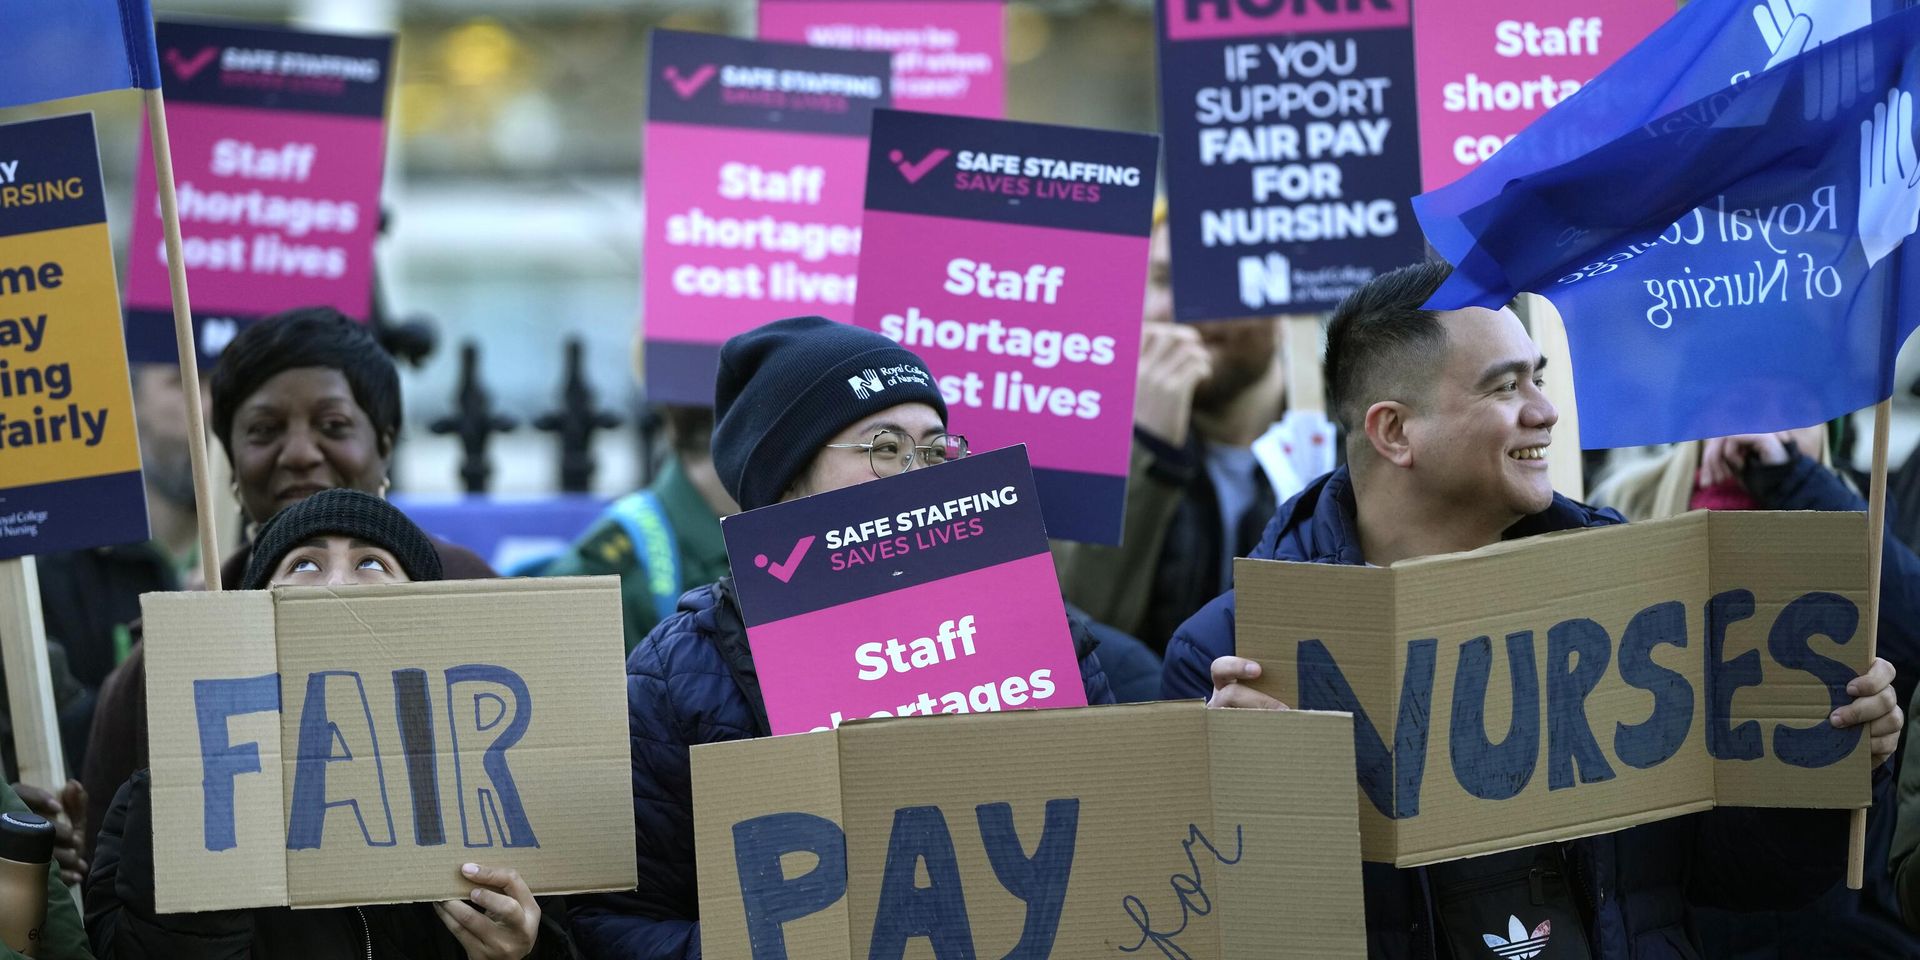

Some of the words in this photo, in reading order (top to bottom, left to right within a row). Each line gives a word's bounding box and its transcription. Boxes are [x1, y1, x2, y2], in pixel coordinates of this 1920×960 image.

[1224, 44, 1261, 81] IF
[1266, 38, 1357, 79] YOU
[1494, 17, 1603, 57] Staff
[720, 65, 776, 91] SAFE
[780, 69, 882, 98] STAFFING
[1195, 77, 1391, 125] SUPPORT
[1443, 73, 1592, 112] shorta
[211, 138, 316, 183] Staff
[1200, 123, 1301, 165] FAIR
[1305, 118, 1391, 159] PAY
[1453, 134, 1518, 166] co
[717, 161, 826, 205] Staff
[955, 172, 1030, 197] SAVES
[1035, 180, 1101, 203] LIVES
[956, 151, 1021, 175] SAFE
[1023, 158, 1140, 187] STAFFING
[1251, 162, 1343, 203] FOR
[155, 181, 359, 237] hortages
[1201, 199, 1398, 247] NURSING
[251, 233, 347, 279] lives
[671, 262, 765, 300] cost
[943, 258, 1066, 304] Staff
[879, 306, 1117, 369] shortages
[880, 363, 904, 376] Royal
[887, 376, 898, 387] of
[937, 371, 984, 408] st
[992, 370, 1102, 420] lives
[825, 517, 893, 550] SAFE
[896, 485, 1019, 532] STAFFING
[830, 536, 911, 572] SAVES
[915, 517, 984, 551] LIVES
[854, 615, 977, 681] Staff
[808, 668, 1056, 733] rtages
[1297, 588, 1865, 820] NURSES
[193, 664, 541, 851] FAIR
[731, 798, 1081, 960] PAY
[1118, 823, 1243, 960] for
